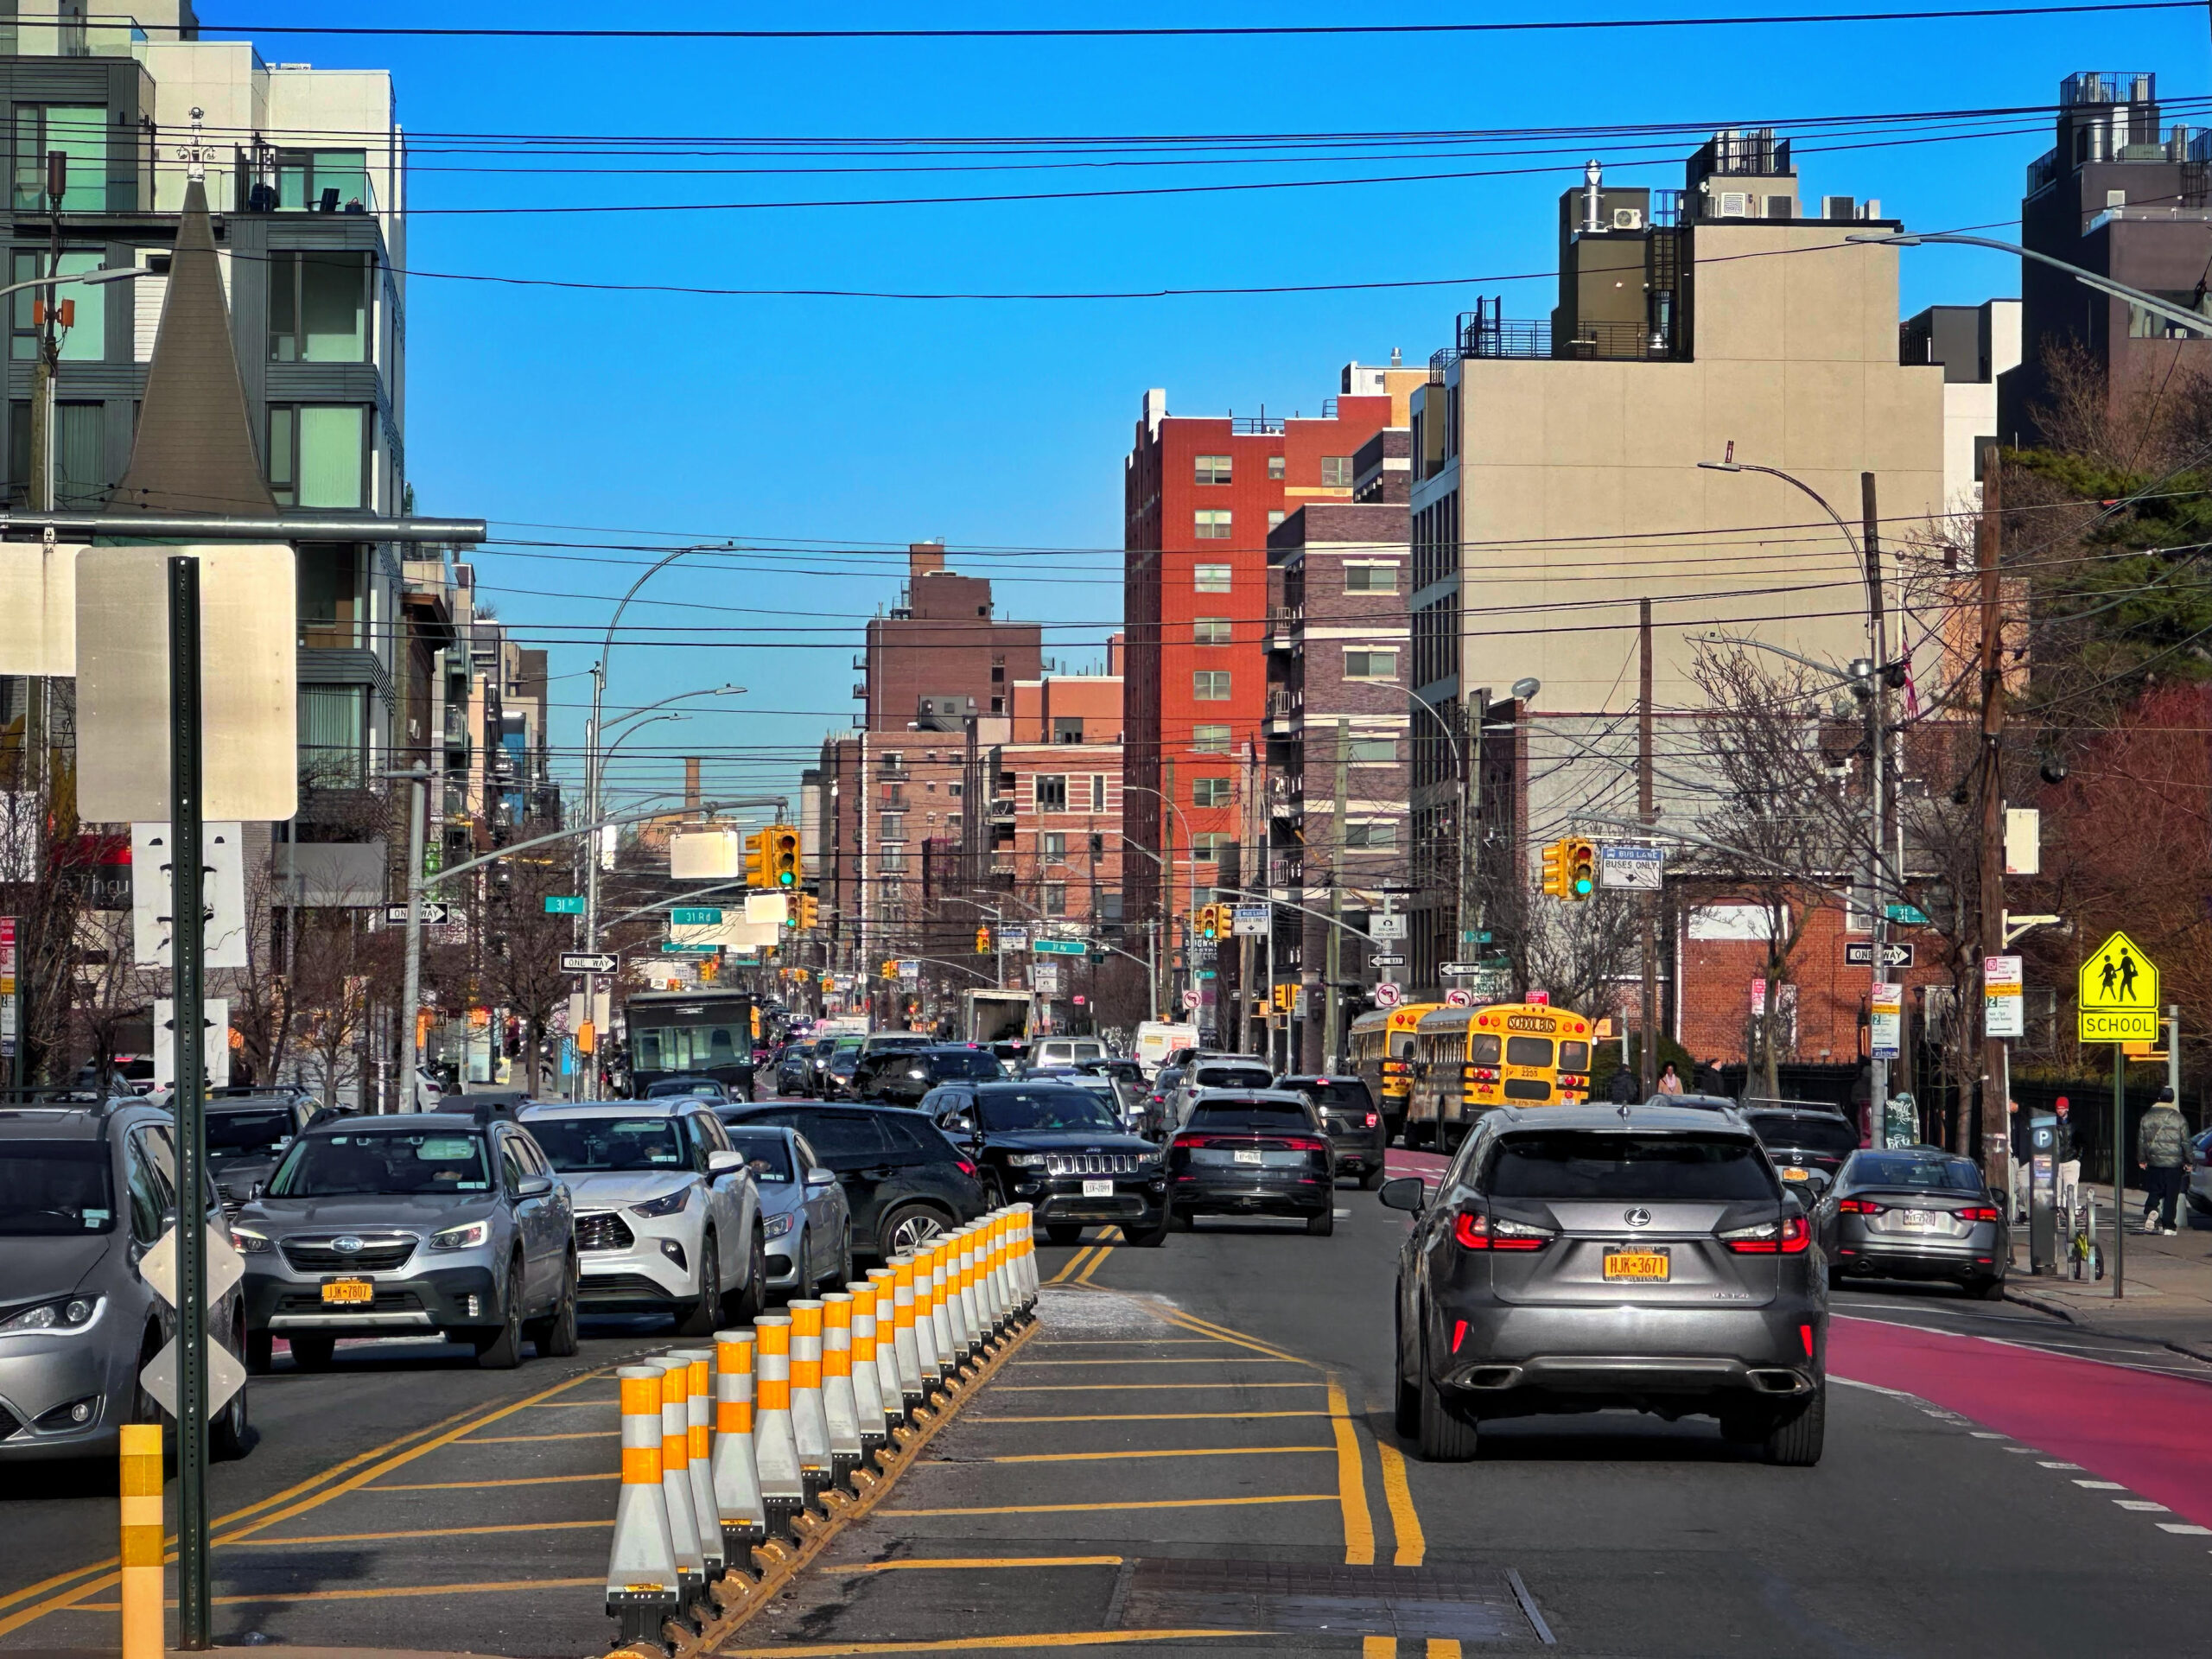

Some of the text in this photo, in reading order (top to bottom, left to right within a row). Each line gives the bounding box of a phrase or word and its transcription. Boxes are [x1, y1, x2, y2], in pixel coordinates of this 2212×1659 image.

[1605, 860, 1632, 868] BUSES
[556, 899, 565, 911] 31
[686, 912, 711, 921] 31 Rd
[2086, 1018, 2152, 1033] SCHOOL
[2039, 1130, 2050, 1146] P
